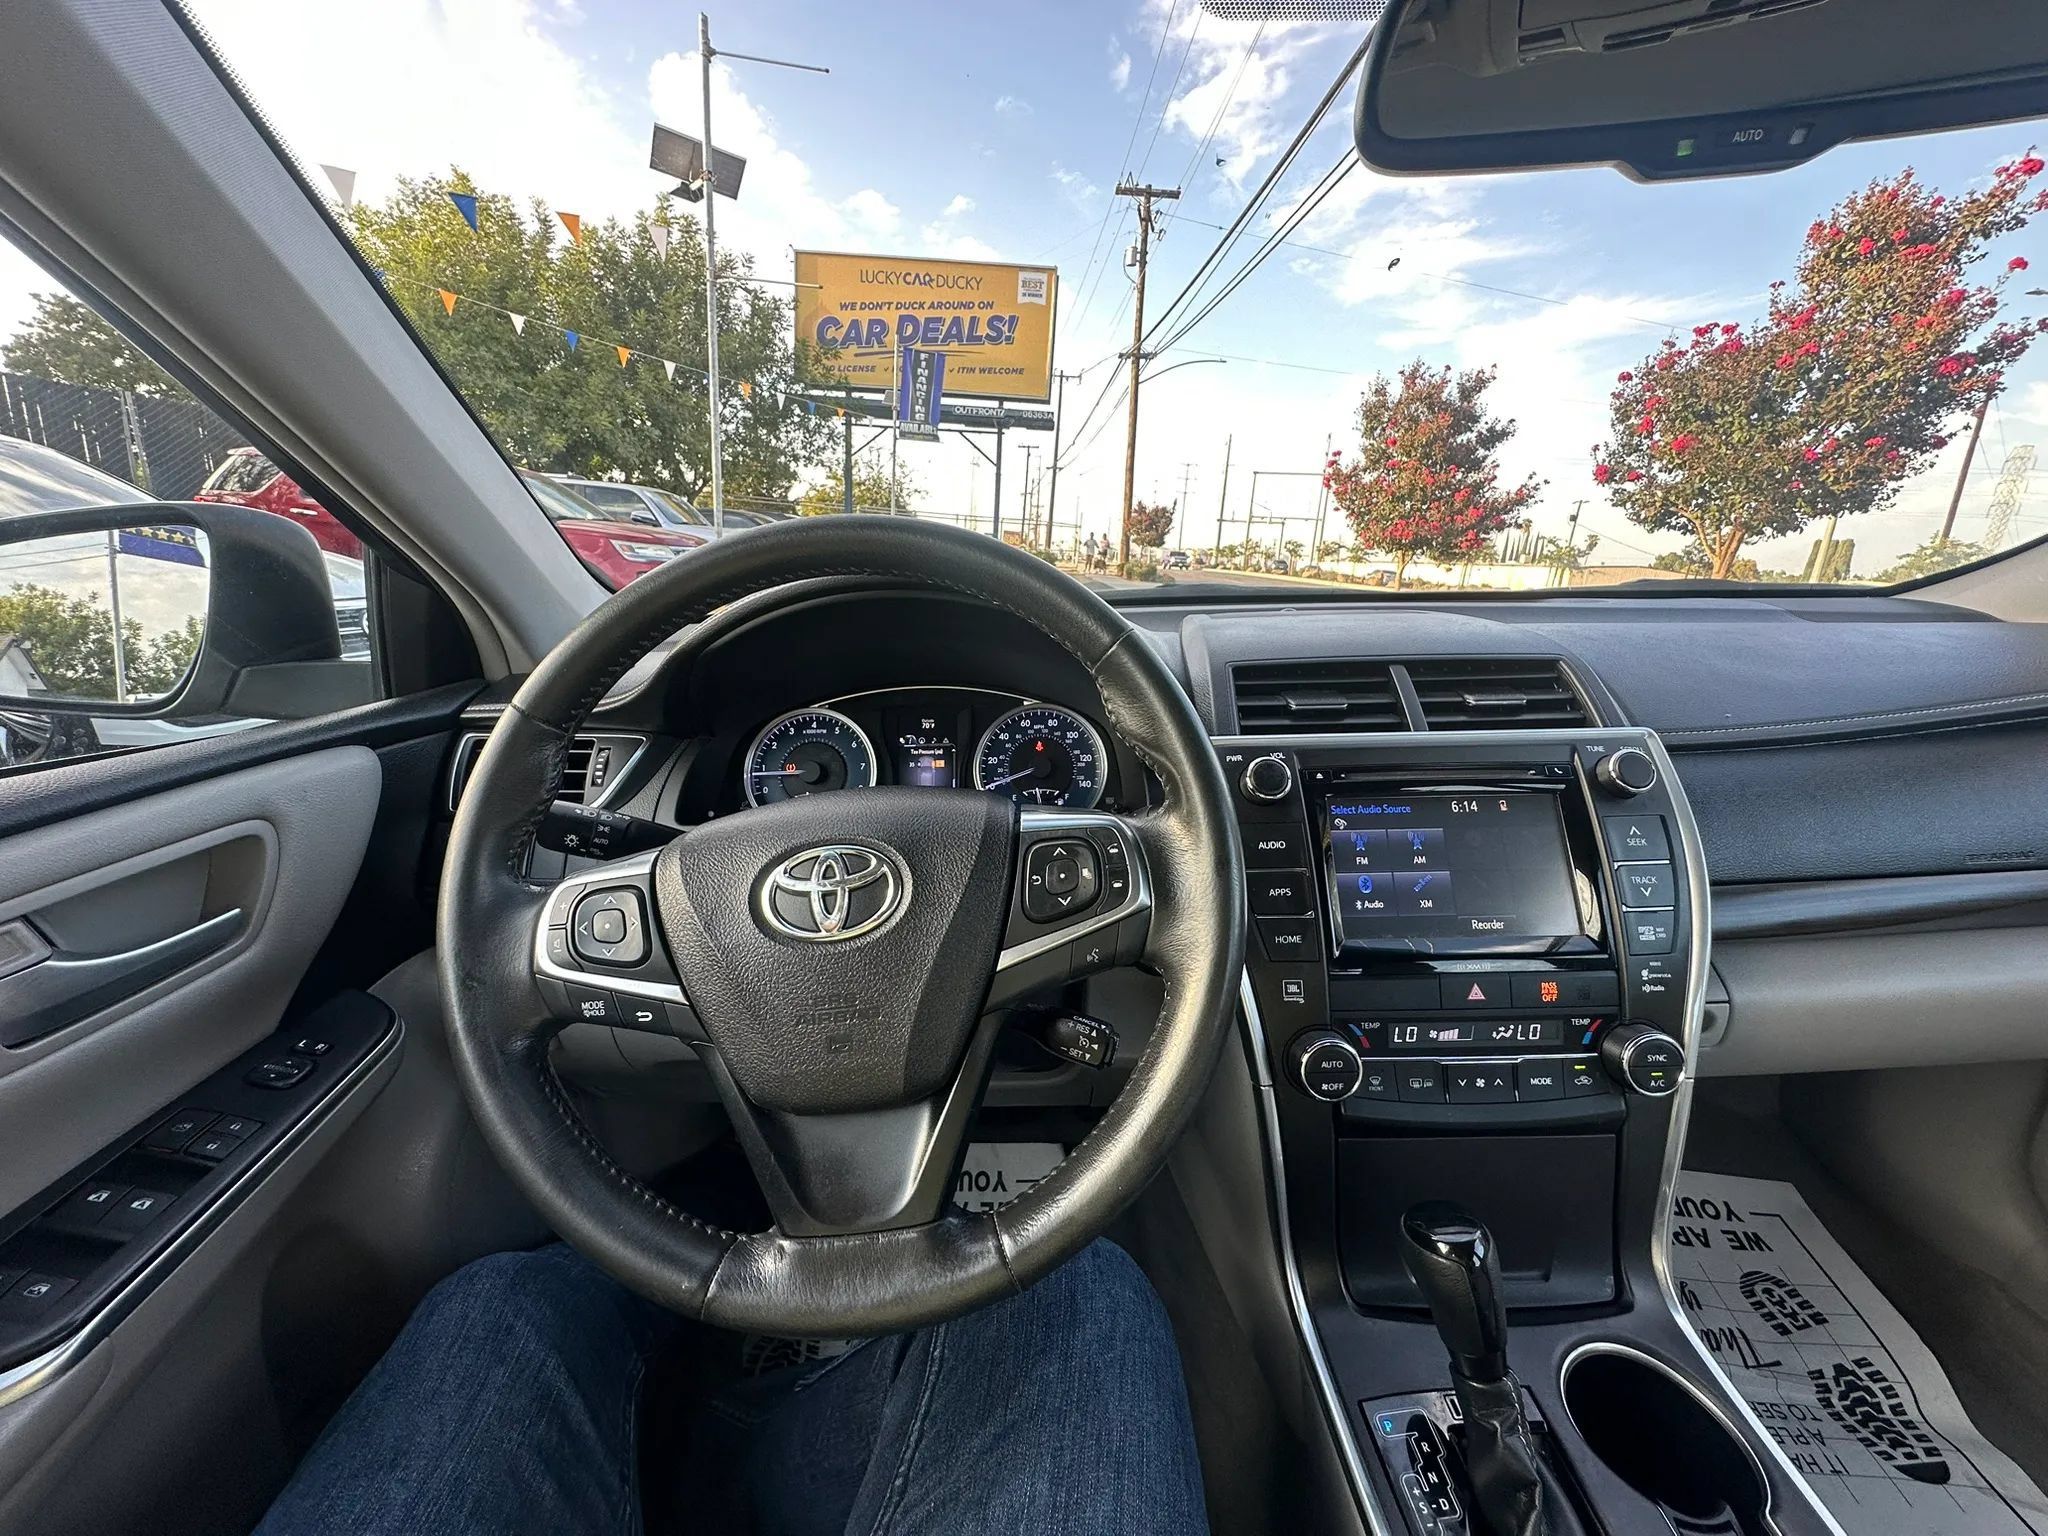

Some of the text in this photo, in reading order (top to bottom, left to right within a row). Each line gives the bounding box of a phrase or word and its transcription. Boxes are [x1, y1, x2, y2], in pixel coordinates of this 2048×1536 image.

[1732, 129, 1764, 142] AUTO
[1021, 280, 1044, 289] BEST
[839, 301, 994, 311] WE DON'T DUCK AROUND ON
[816, 314, 1020, 348] CAR DEALS!
[957, 367, 1025, 376] ITIN WELCOME
[914, 352, 929, 421] FINANCING
[1020, 719, 1031, 727] 60
[1047, 719, 1058, 727] 80
[1066, 731, 1078, 739] 100
[1079, 754, 1092, 762] 120
[1226, 754, 1243, 762] PWR
[1078, 780, 1091, 788] 140
[1331, 803, 1411, 815] Select Audio Source
[1451, 800, 1479, 813] 6:14
[593, 837, 609, 845] AUTO
[1258, 840, 1286, 850] AUDIO
[1626, 838, 1648, 846] SEEK
[1356, 857, 1369, 865] FM
[1413, 856, 1427, 864] AM
[1630, 876, 1658, 884] TRACK
[1269, 888, 1292, 897] APPS
[1363, 900, 1385, 909] Audio
[1419, 899, 1433, 908] XM
[1471, 919, 1505, 930] Reorder
[1275, 935, 1303, 944] HOME
[1541, 993, 1558, 1002] OFF
[581, 1000, 605, 1010] MODE
[1073, 1015, 1100, 1029] CANCEL
[1360, 1022, 1381, 1030] TEMP
[1570, 1018, 1591, 1026] TEMP
[1075, 1023, 1090, 1034] RES
[1516, 1024, 1541, 1040] LO
[298, 1039, 306, 1047] L
[1068, 1047, 1083, 1057] SET
[1647, 1054, 1668, 1062] SYNC
[1321, 1060, 1344, 1068] AUTO
[1530, 1077, 1553, 1085] MODE
[1649, 1079, 1665, 1087] A/C
[1328, 1083, 1344, 1091] OFF
[958, 1170, 1008, 1193] YOU
[1671, 1225, 1774, 1253] WE AP
[1787, 1403, 1823, 1422] TO
[1383, 1420, 1392, 1432] P
[1420, 1441, 1431, 1453] R
[1427, 1471, 1439, 1484] N
[1418, 1498, 1450, 1514] S D
